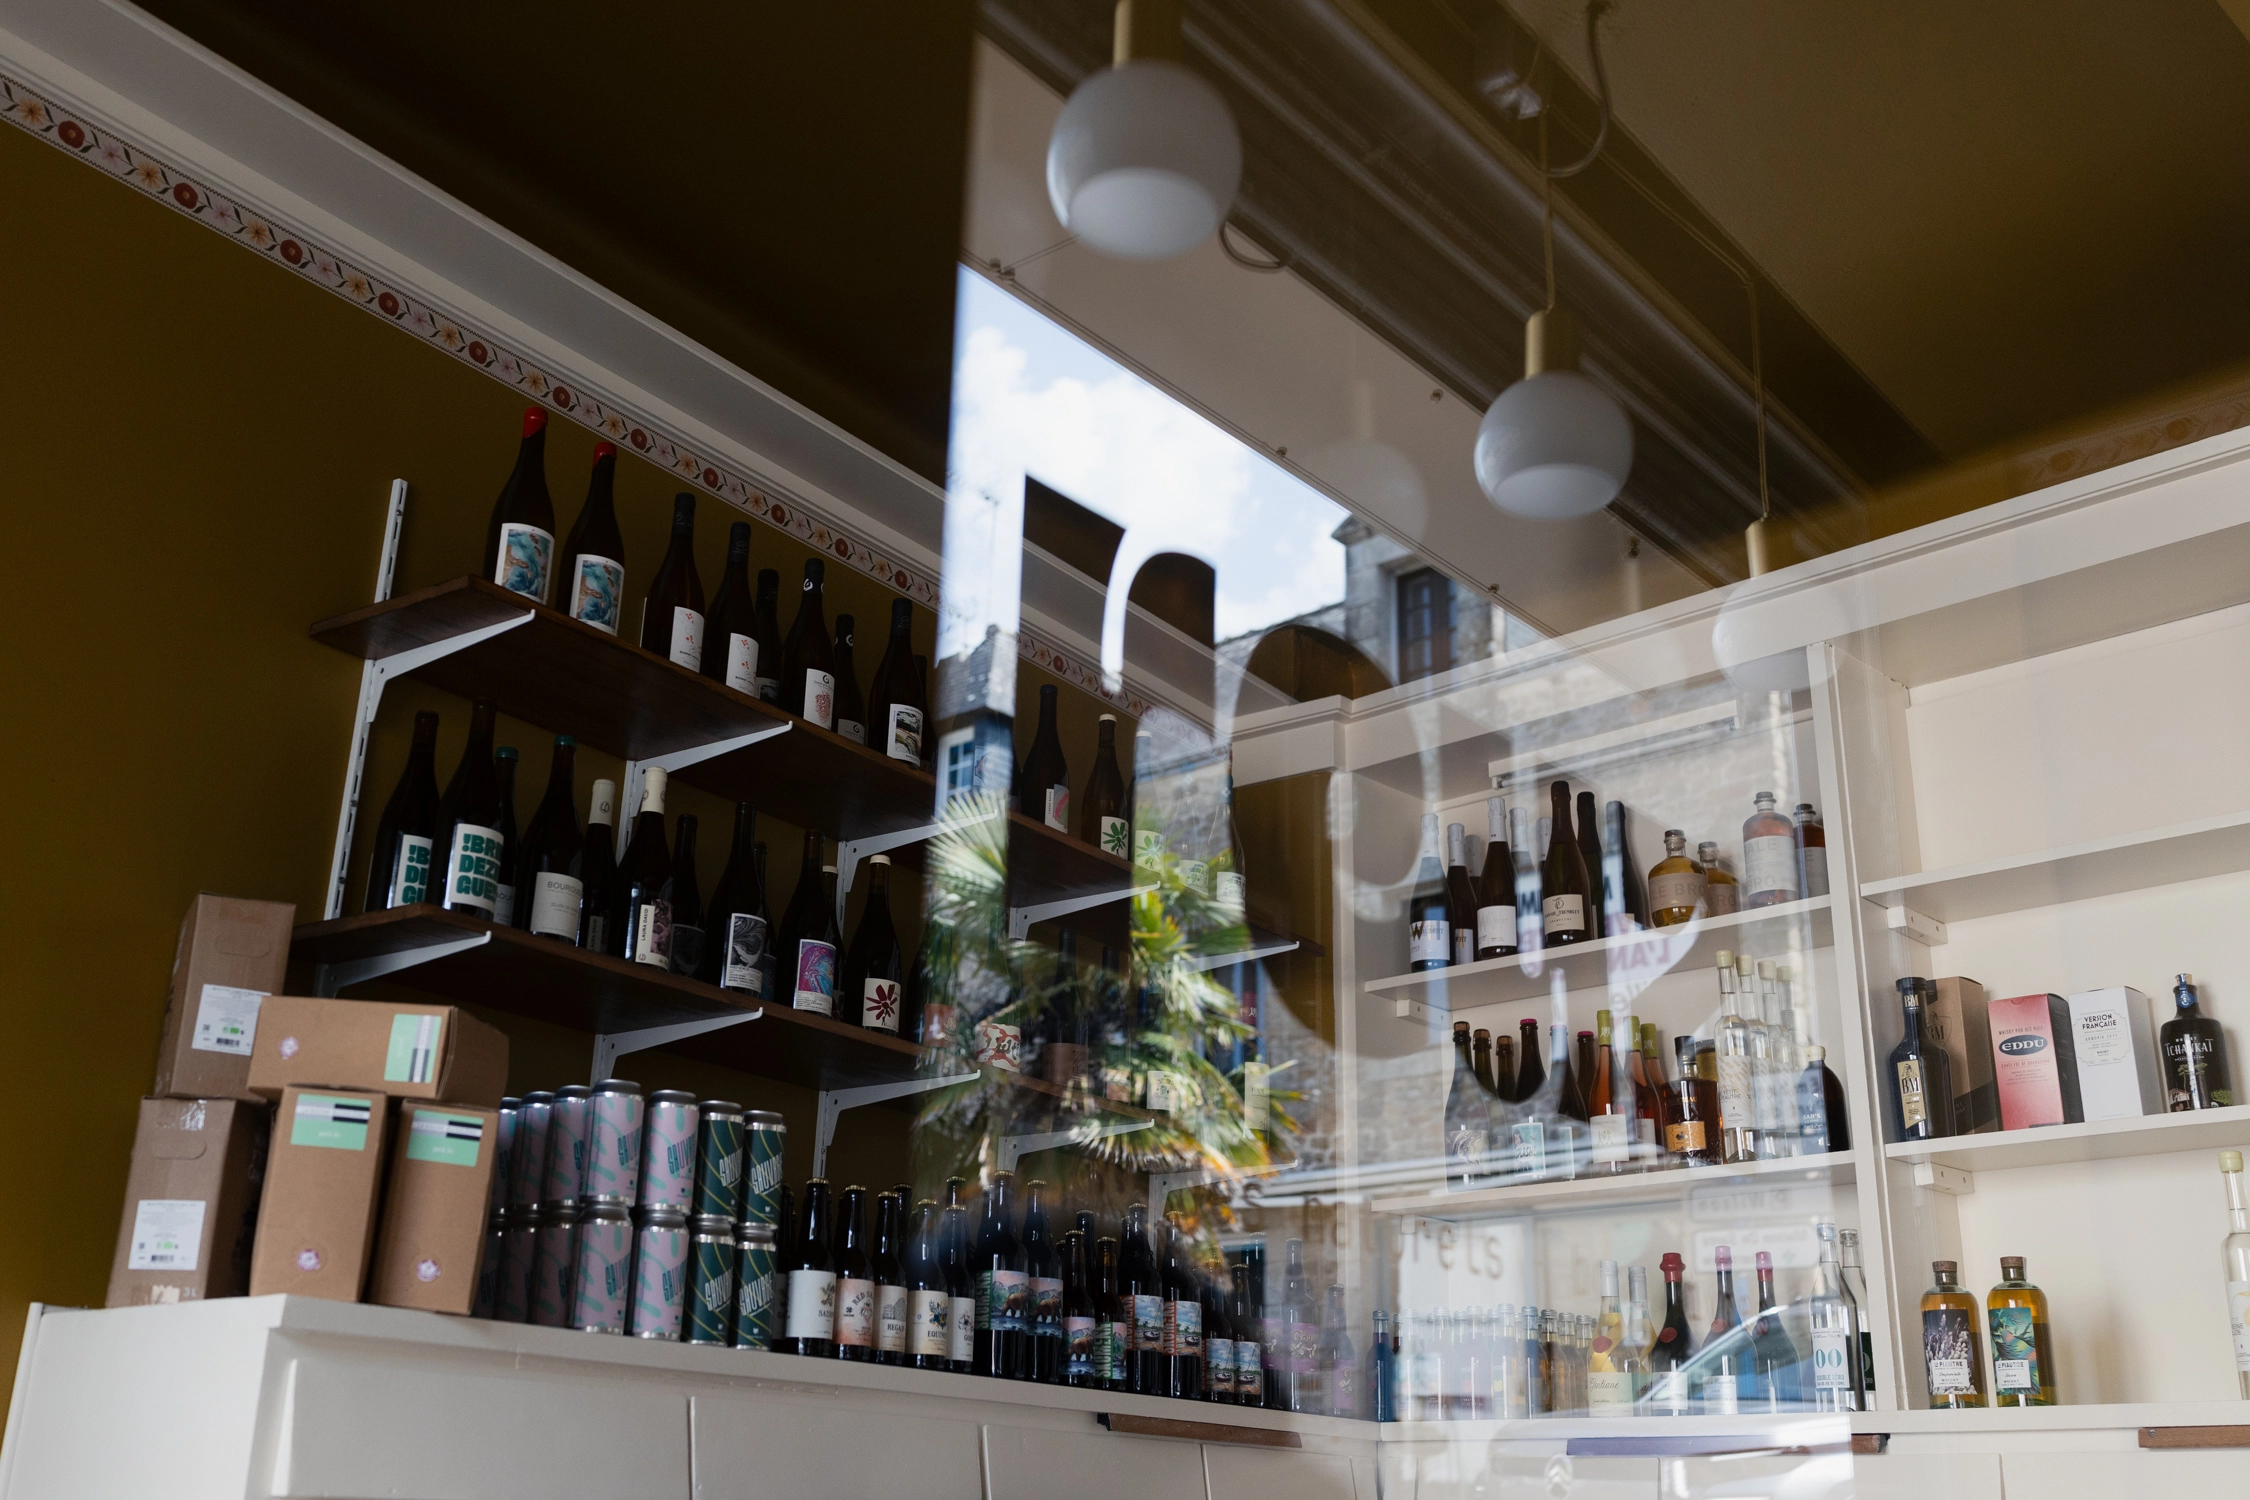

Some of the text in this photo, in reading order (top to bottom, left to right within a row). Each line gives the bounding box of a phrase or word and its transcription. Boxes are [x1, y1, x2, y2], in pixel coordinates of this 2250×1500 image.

[2084, 1013, 2112, 1023] VERSION
[2082, 1019, 2117, 1030] FRANÇAISE
[1998, 1028, 2014, 1036] WHISKY
[2001, 1039, 2045, 1052] EDDU
[1902, 1077, 1920, 1095] BM
